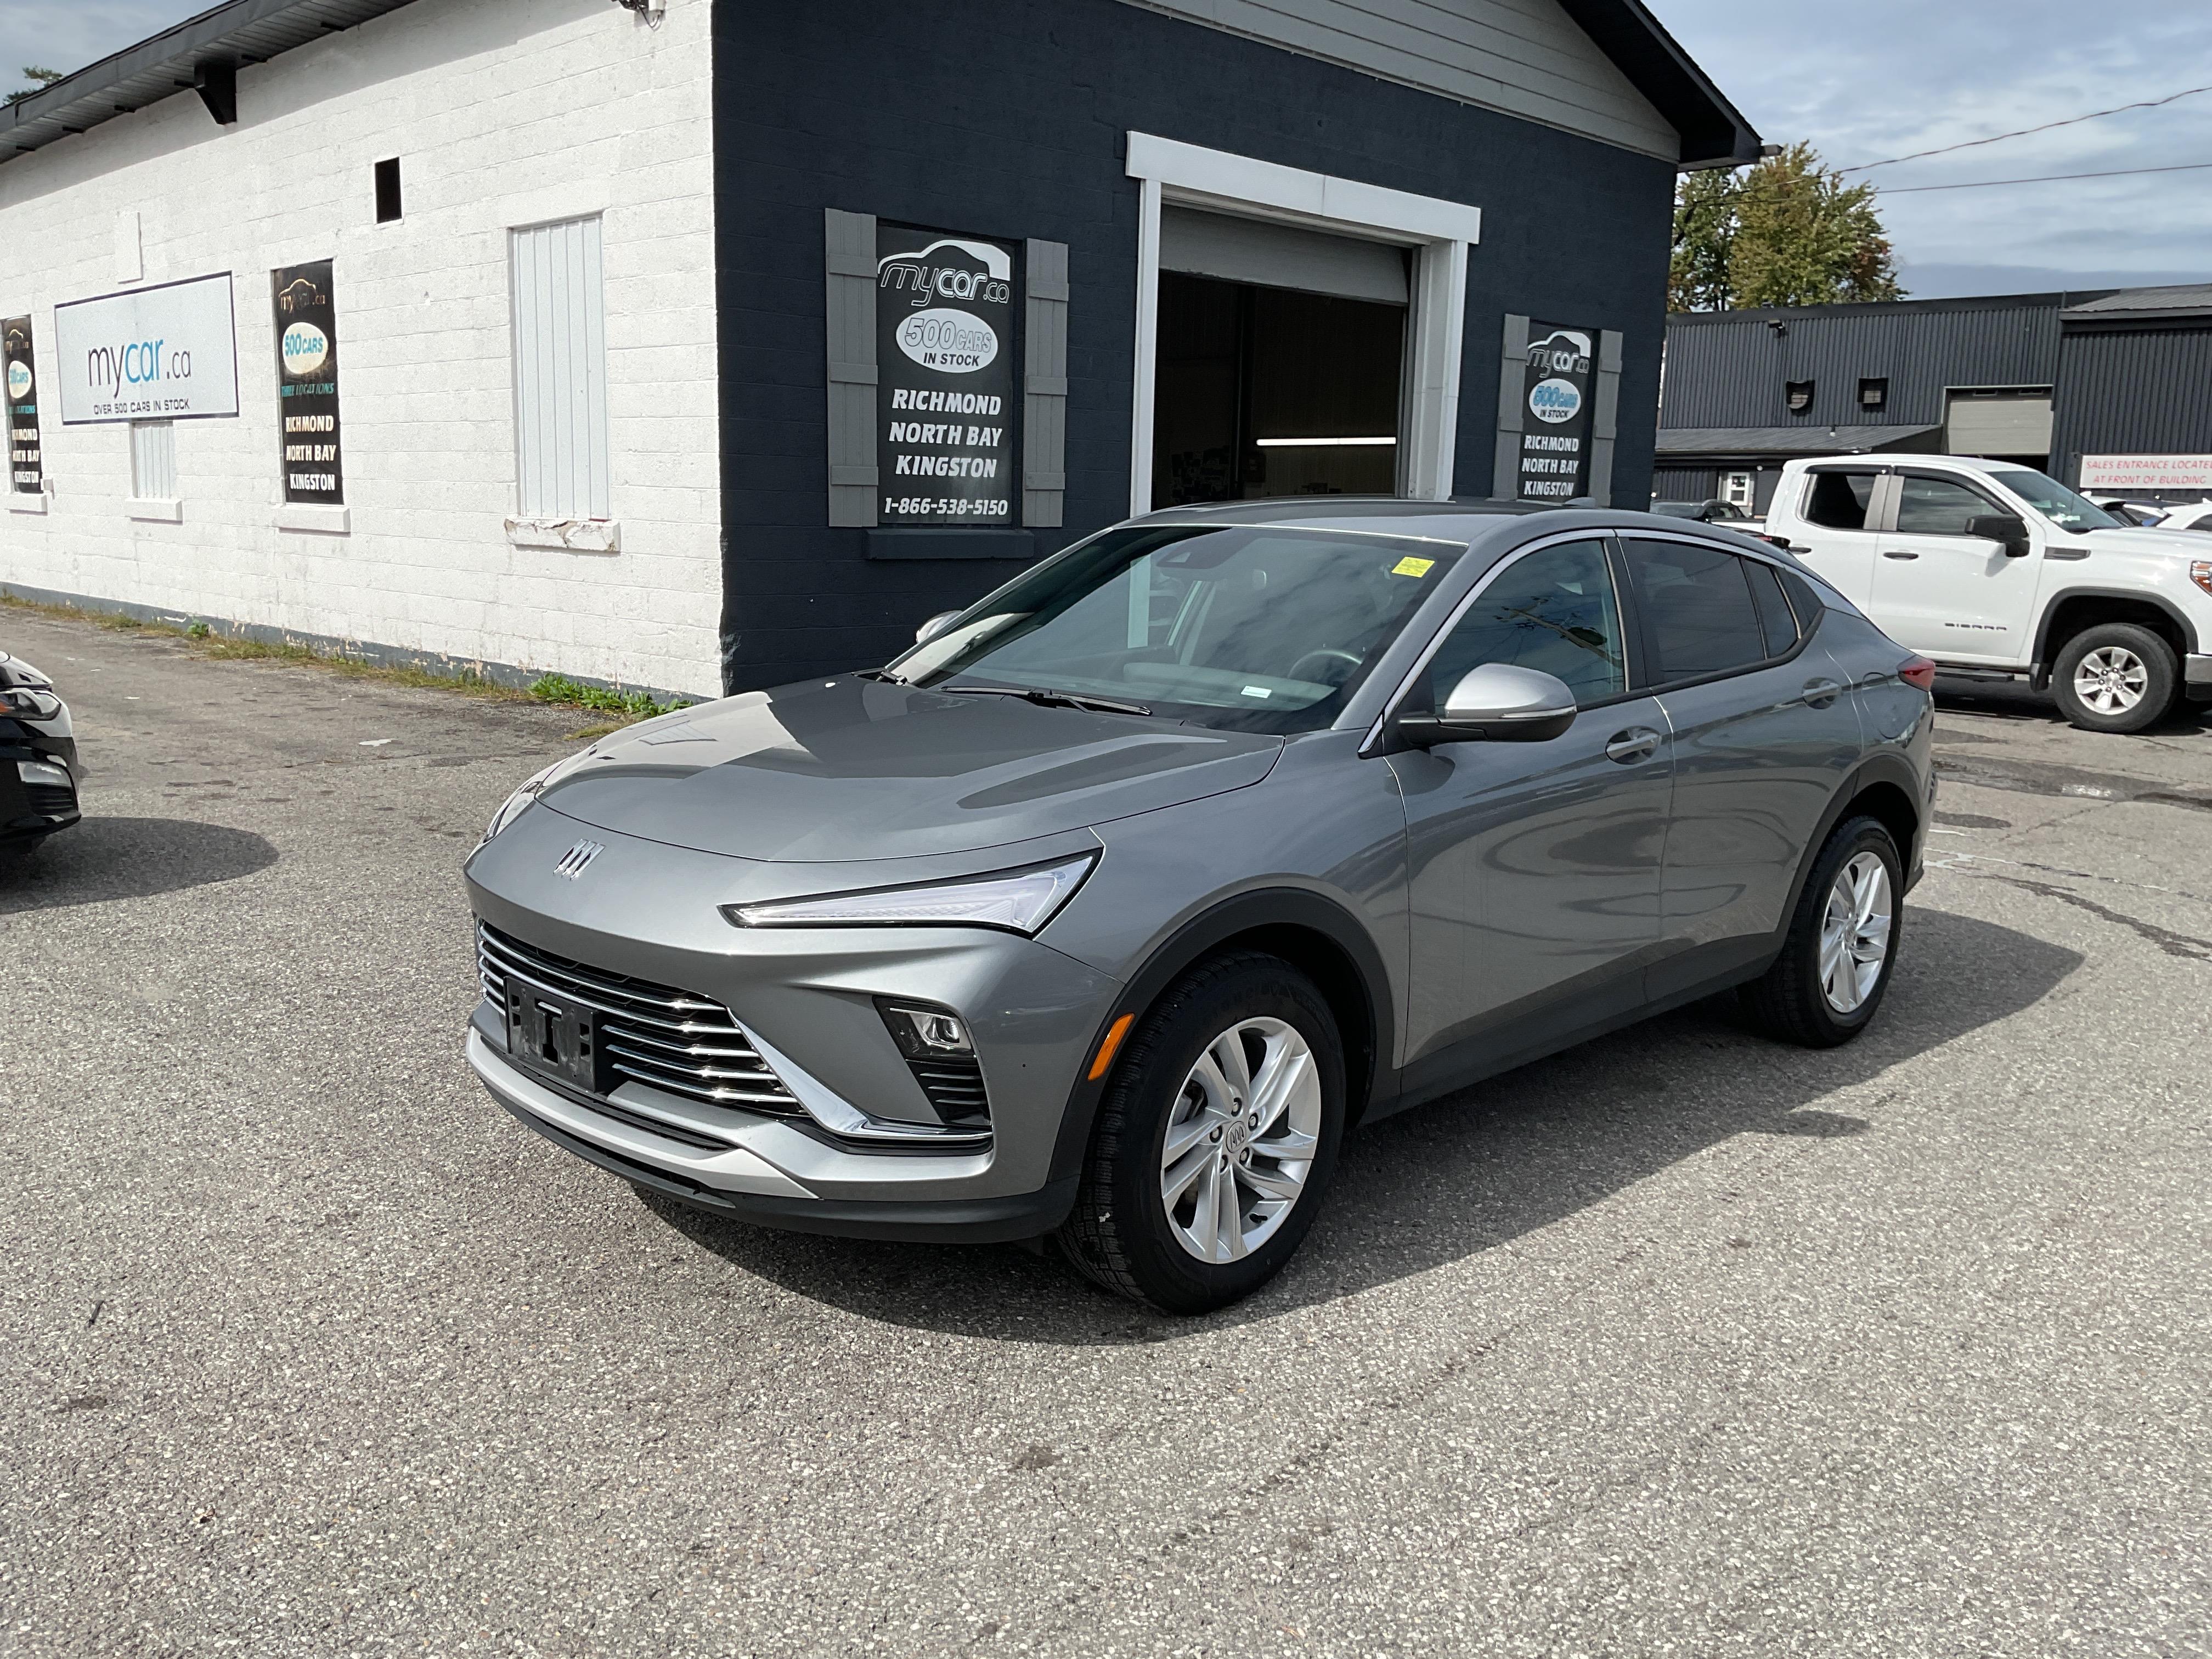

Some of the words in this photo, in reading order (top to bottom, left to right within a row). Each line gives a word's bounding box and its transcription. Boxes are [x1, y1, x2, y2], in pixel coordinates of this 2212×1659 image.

[923, 352, 937, 364] IN
[940, 353, 980, 366] STOCK
[93, 404, 112, 415] OVER
[115, 403, 127, 414] 500
[131, 401, 150, 413] CARS
[154, 400, 161, 411] IN
[165, 398, 190, 411] STOCK
[891, 388, 1001, 415] RICHMOND
[1548, 409, 1570, 418] STOCK
[285, 415, 334, 432] RICHMOND
[889, 422, 962, 445] NORTH
[966, 426, 1002, 447] BAY
[1524, 435, 1579, 452] RICHMOND
[286, 445, 312, 461] NORTH
[314, 444, 336, 461] BAY
[895, 455, 997, 478] KINGSTON
[1522, 458, 1558, 474] NORTH
[1559, 460, 1579, 475] BAY
[2086, 461, 2113, 469] SALES
[2117, 460, 2169, 469] ENTRANCE
[290, 473, 335, 490] KINGSTON
[2093, 475, 2106, 484] AT
[2108, 475, 2140, 484] FRONT
[2143, 475, 2155, 484] OF
[2159, 475, 2207, 484] BUILDING
[1523, 481, 1575, 496] KINGSTON
[884, 497, 1008, 516] 1-866-538-5150
